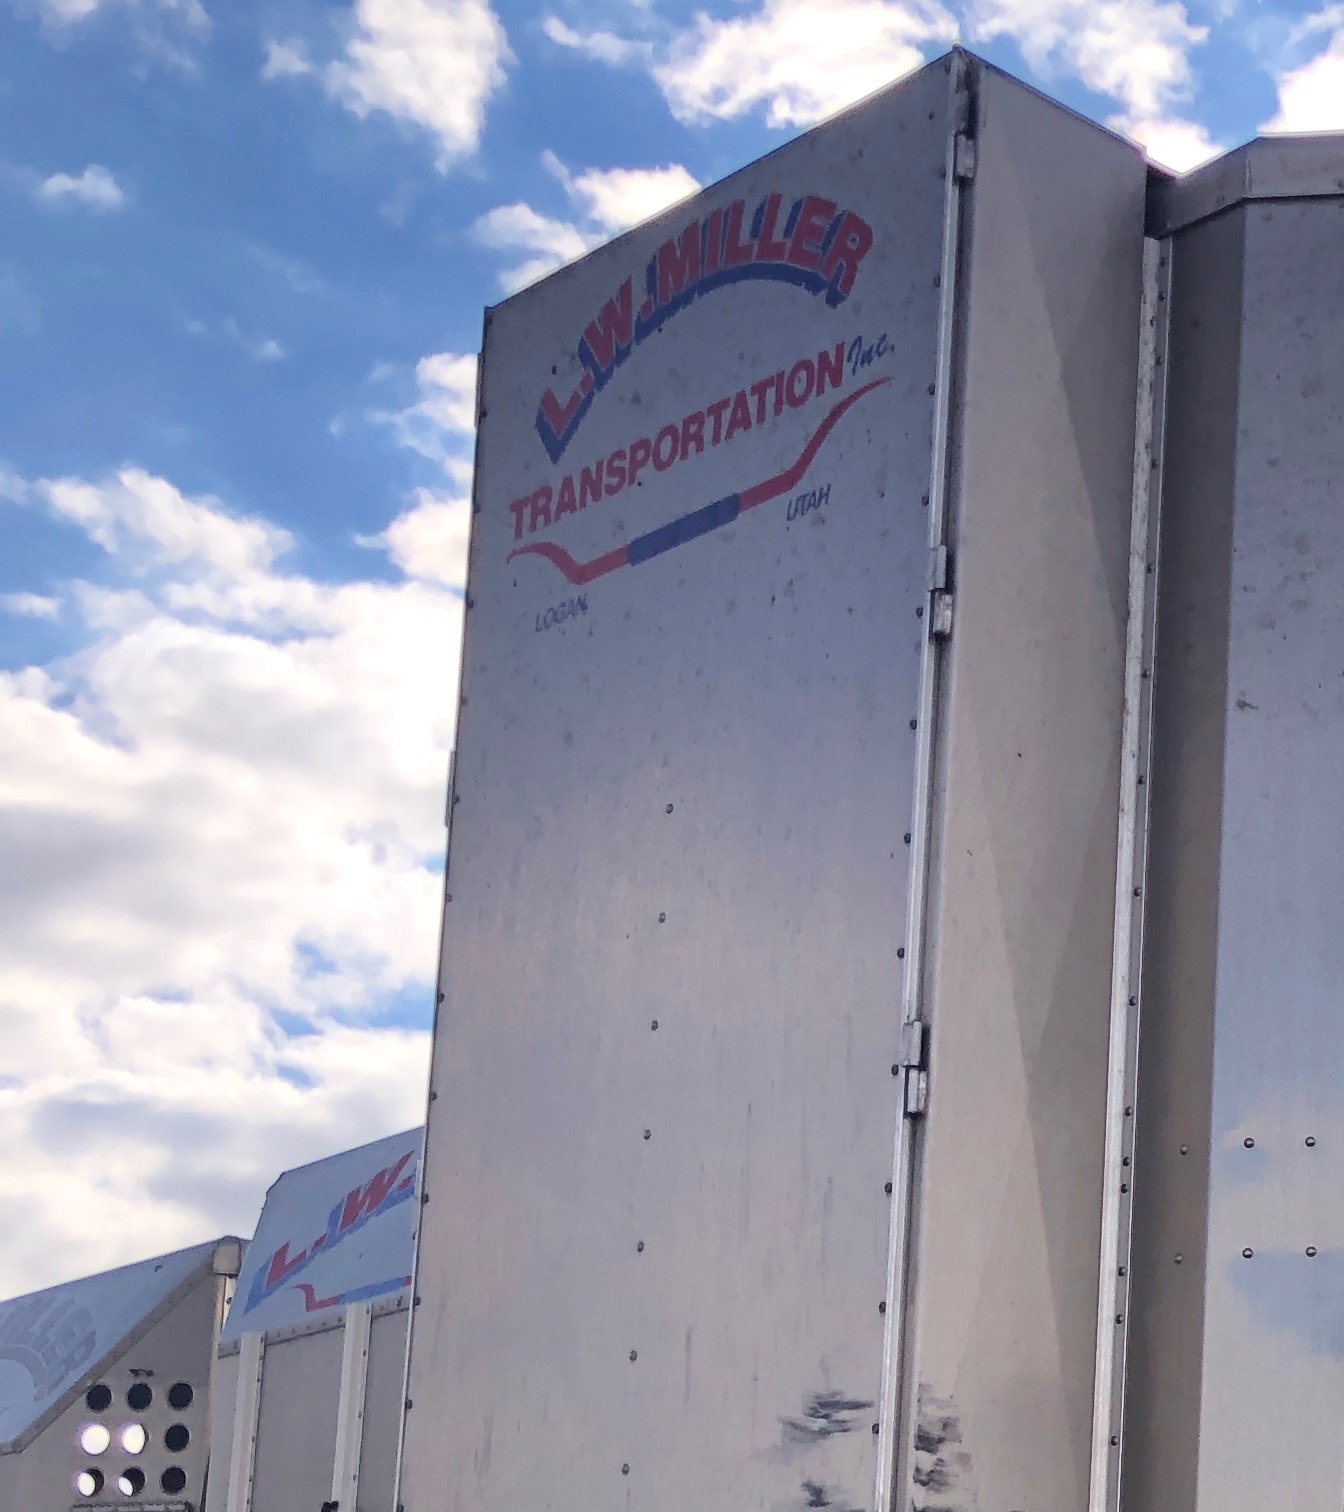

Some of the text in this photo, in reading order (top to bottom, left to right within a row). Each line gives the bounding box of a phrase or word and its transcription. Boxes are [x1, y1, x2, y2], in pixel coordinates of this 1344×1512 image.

[510, 332, 896, 540] TRANSPORTATION Inc.
[786, 483, 831, 521] UTAH
[534, 593, 590, 633] LOGAN
